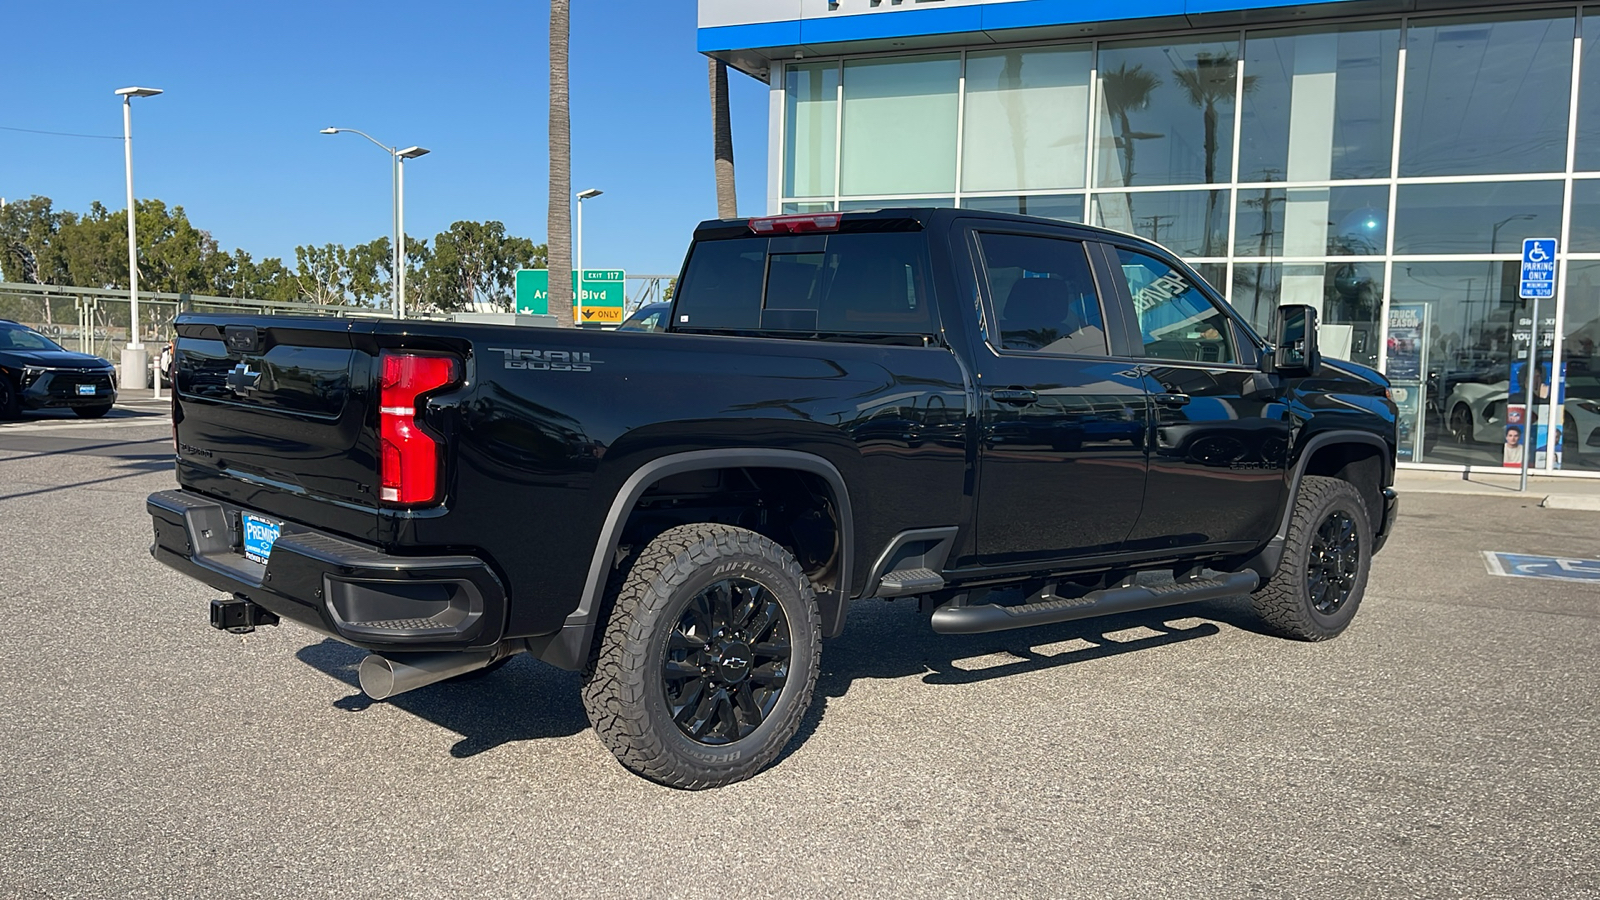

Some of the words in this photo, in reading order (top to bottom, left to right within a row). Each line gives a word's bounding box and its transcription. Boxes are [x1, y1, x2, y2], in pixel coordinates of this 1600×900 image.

[1523, 261, 1553, 271] PARKING
[607, 272, 619, 280] 117
[1528, 271, 1547, 280] ONLY
[582, 290, 607, 300] Blvd
[1390, 309, 1417, 319] TRUCK
[488, 348, 605, 363] TRAIL
[505, 360, 592, 372] BOSS
